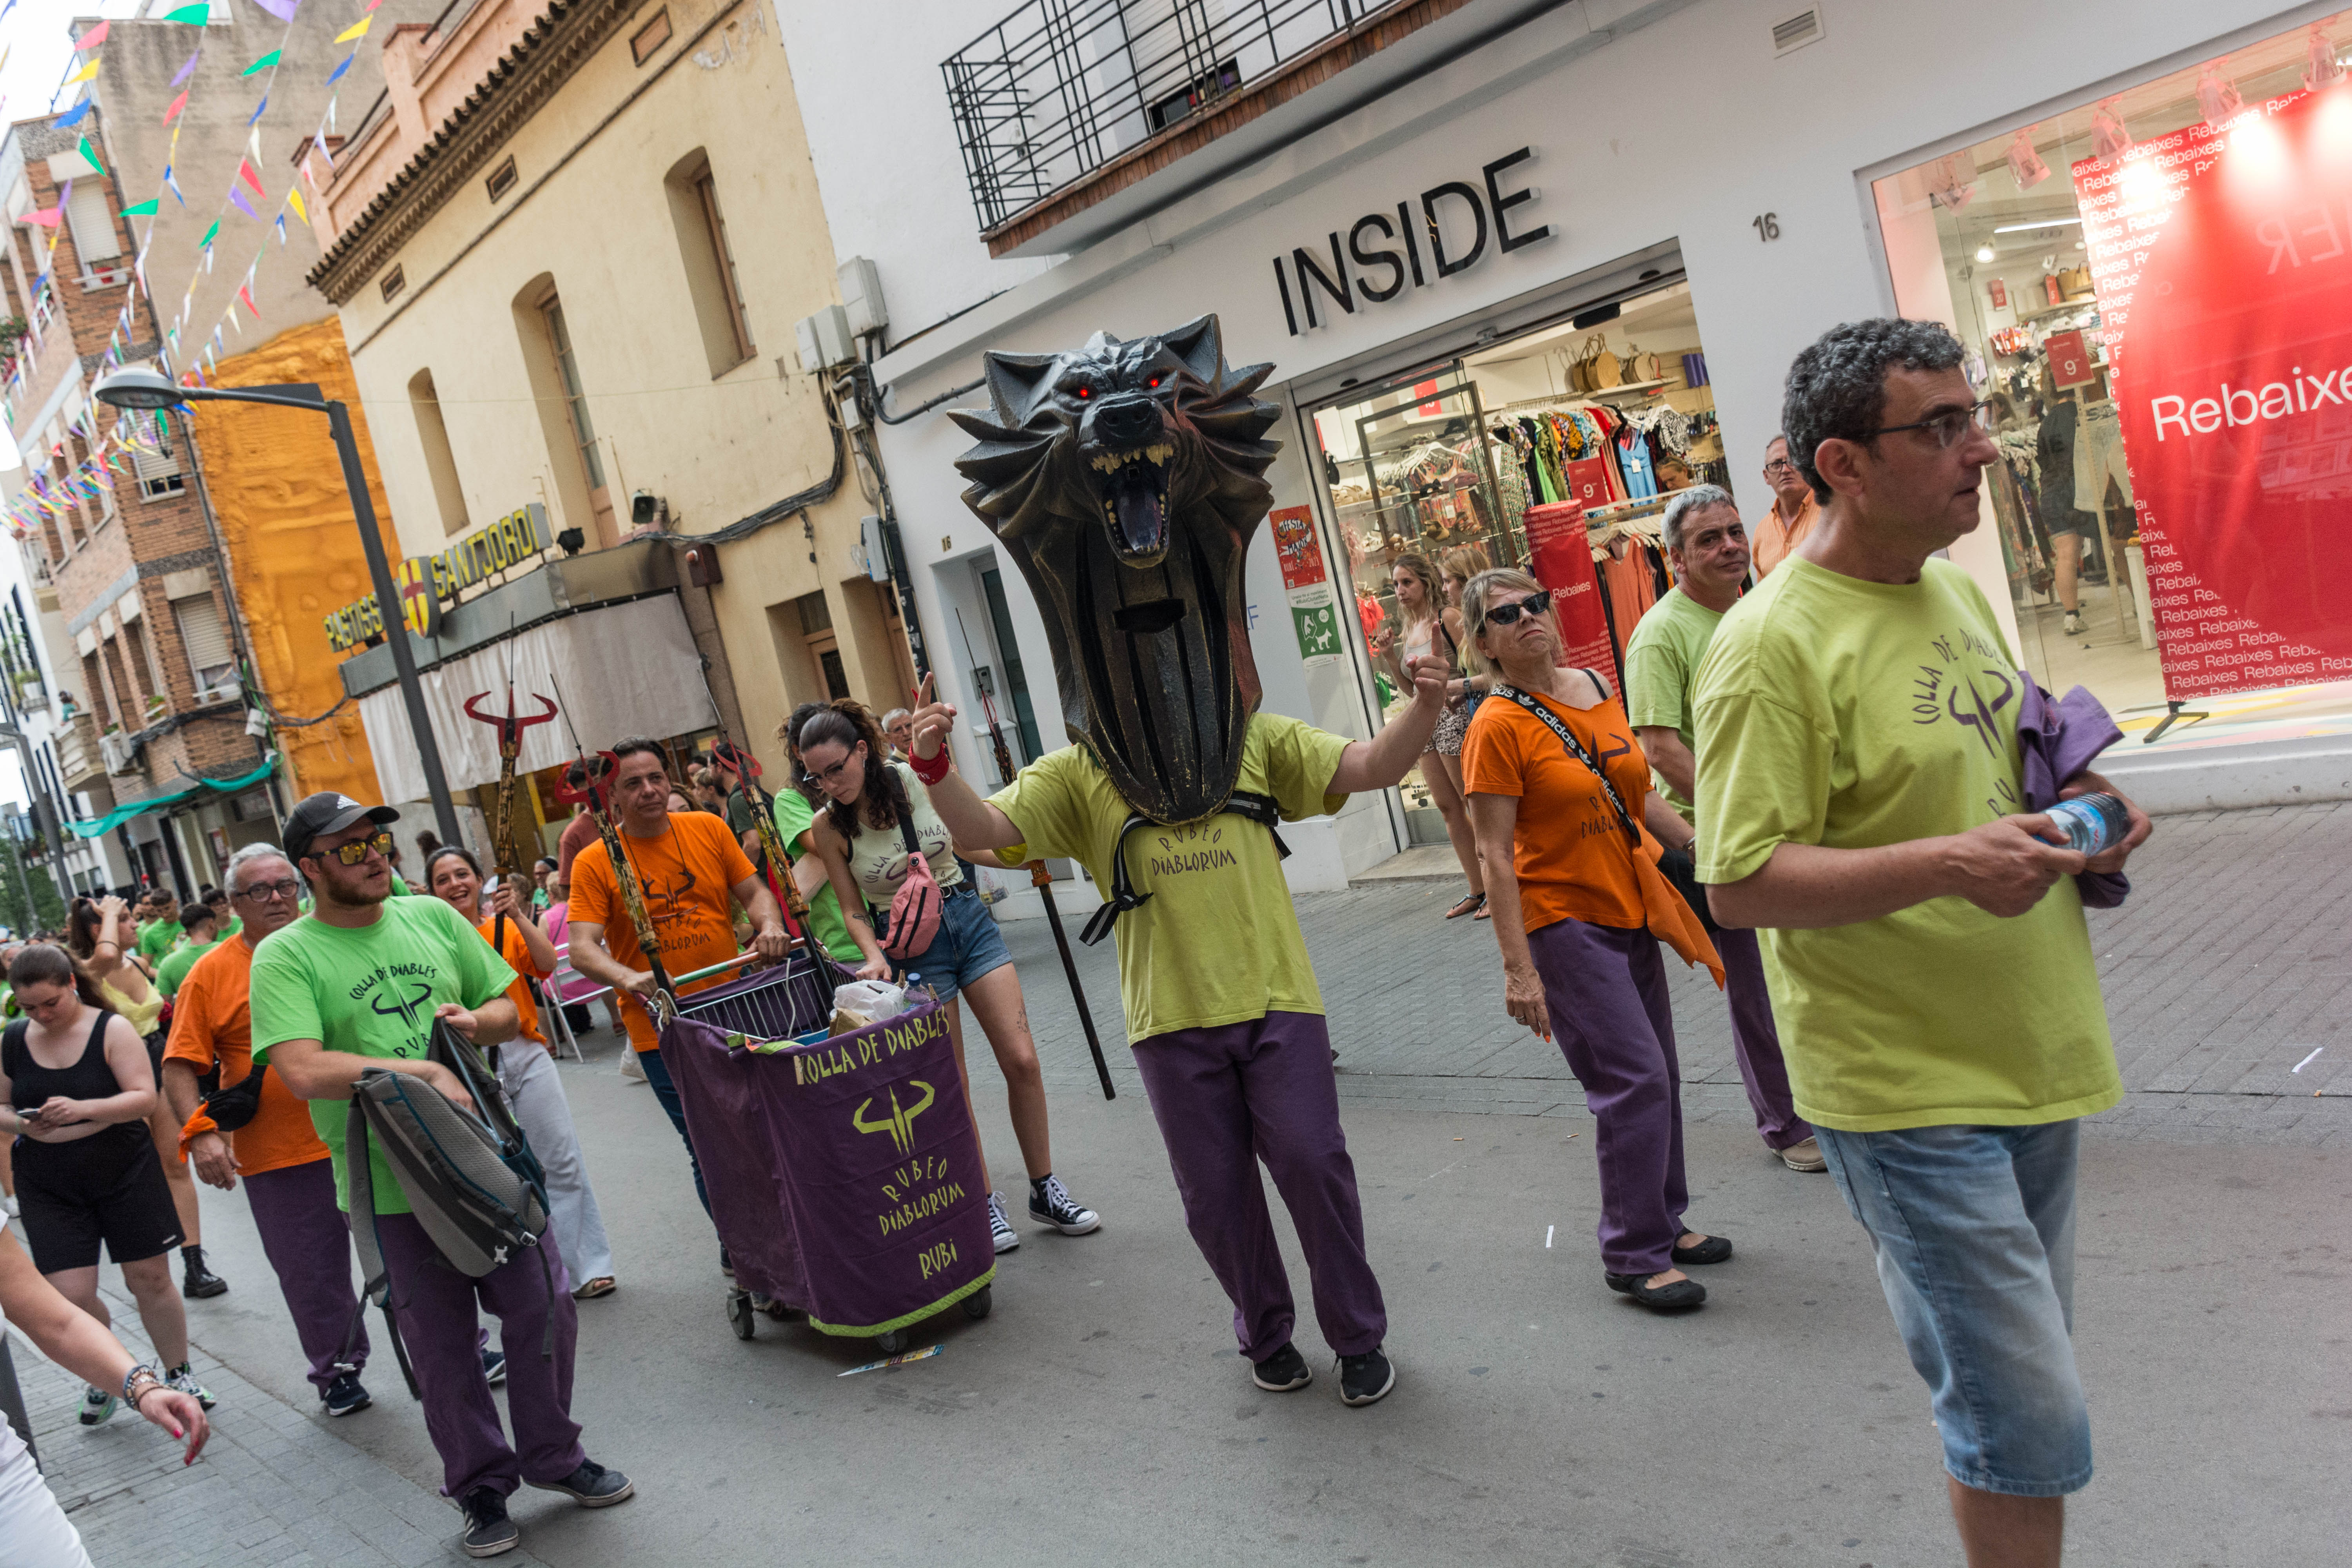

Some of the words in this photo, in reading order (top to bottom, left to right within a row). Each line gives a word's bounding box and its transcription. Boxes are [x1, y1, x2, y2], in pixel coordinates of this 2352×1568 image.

[2154, 138, 2225, 171] Rebaixes
[1753, 212, 1780, 242] 16
[1273, 146, 1555, 337] INSIDE
[2064, 359, 2076, 376] 9
[1583, 483, 1594, 498] 9
[1283, 517, 1304, 532] FESTA
[942, 535, 952, 552] 16
[1287, 536, 1308, 555] MAJOR
[1308, 557, 1319, 568] 2023
[1552, 581, 1591, 600] Rebaixes
[2161, 605, 2228, 624] Rebaixes
[2167, 638, 2233, 656] Rebaixes
[2205, 650, 2273, 668] Rebaixes
[1912, 665, 1943, 724] COLLA
[1931, 634, 1958, 663] DE
[2172, 671, 2238, 689] Rebaixes
[2244, 662, 2314, 679] Rebaixes
[1535, 706, 1577, 750] adidas
[864, 855, 891, 883] COLLA
[349, 974, 378, 1000] COLLA
[375, 967, 390, 981] DE
[857, 1033, 882, 1067] DE
[882, 1156, 947, 1202] RUBEO
